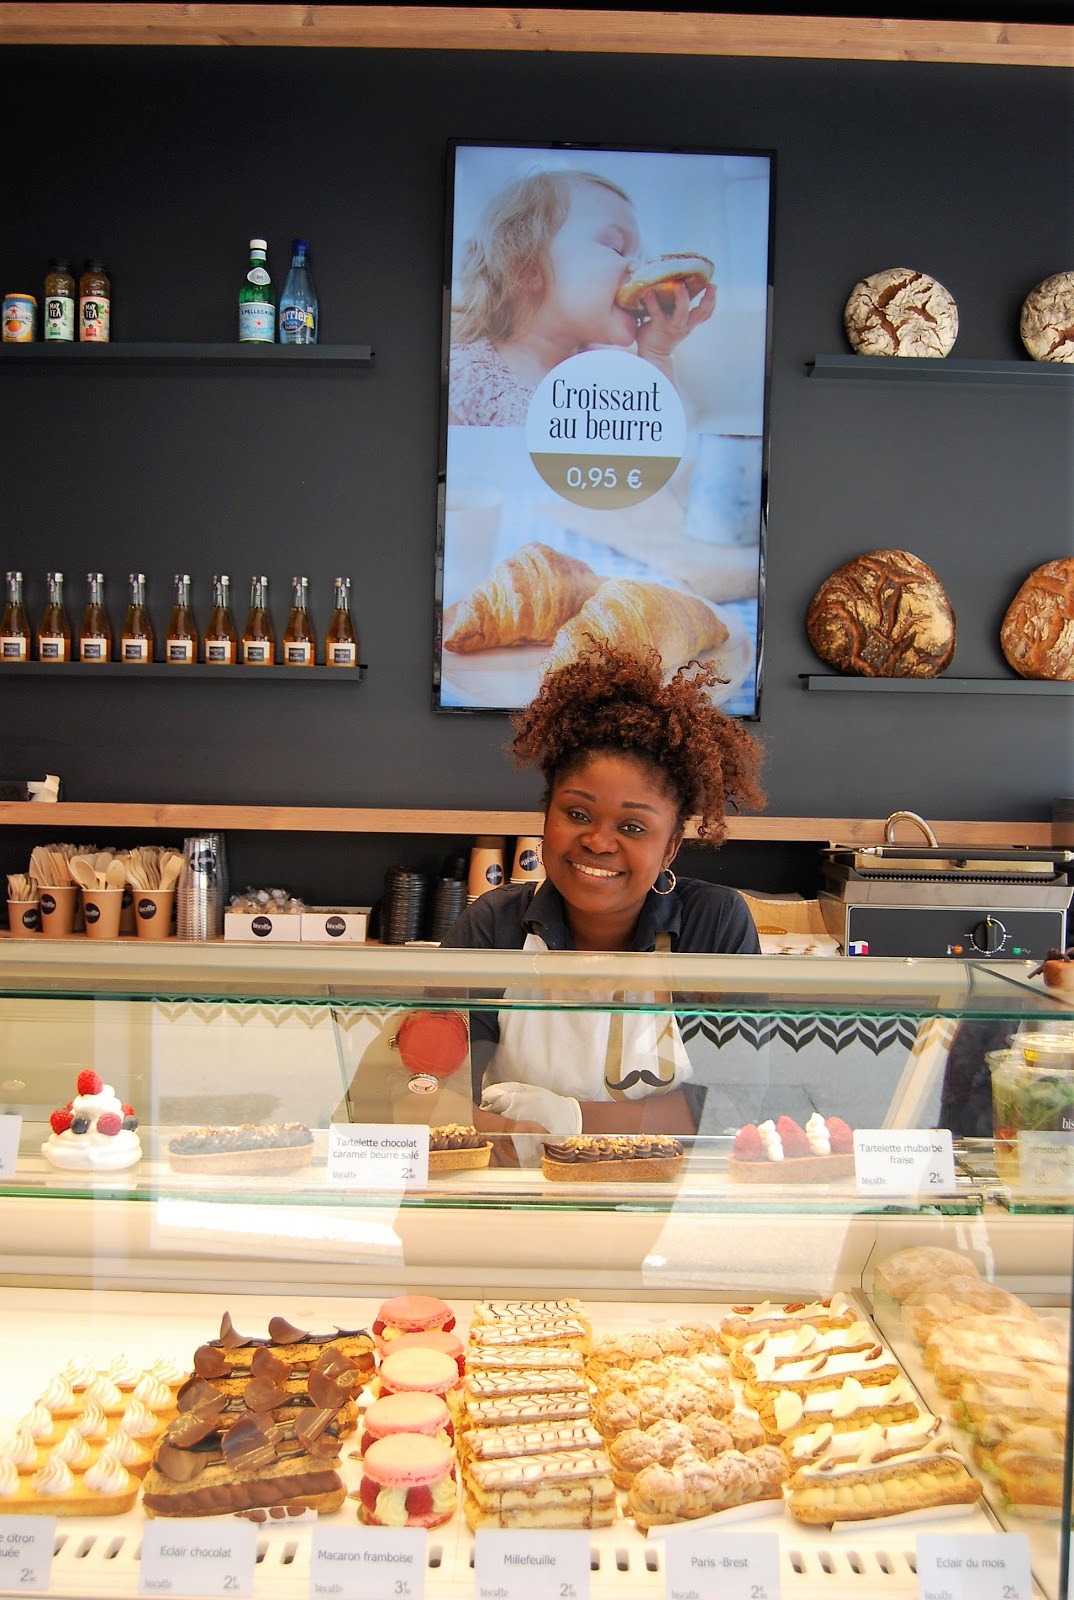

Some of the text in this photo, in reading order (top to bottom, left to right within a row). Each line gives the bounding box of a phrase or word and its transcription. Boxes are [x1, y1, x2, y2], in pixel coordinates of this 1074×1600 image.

[50, 308, 62, 318] TEA
[85, 309, 97, 319] TEA
[552, 379, 662, 412] Croissant
[549, 410, 662, 442] au beurre
[566, 466, 643, 490] 0,95 €
[336, 1137, 417, 1149] Tartelette chocolat
[859, 1143, 943, 1154] Tartelette rhubarbe
[332, 1150, 419, 1160] caramel beurre salé
[889, 1155, 914, 1165] fraise
[6, 1533, 35, 1544] citron
[0, 1546, 20, 1558] uée
[160, 1545, 232, 1558] Eclair chocolat
[317, 1550, 413, 1563] Macaron framboise
[503, 1554, 557, 1566] Millefeuille
[691, 1557, 749, 1568] Paris -Brest
[936, 1556, 1006, 1569] Eclair du mois
